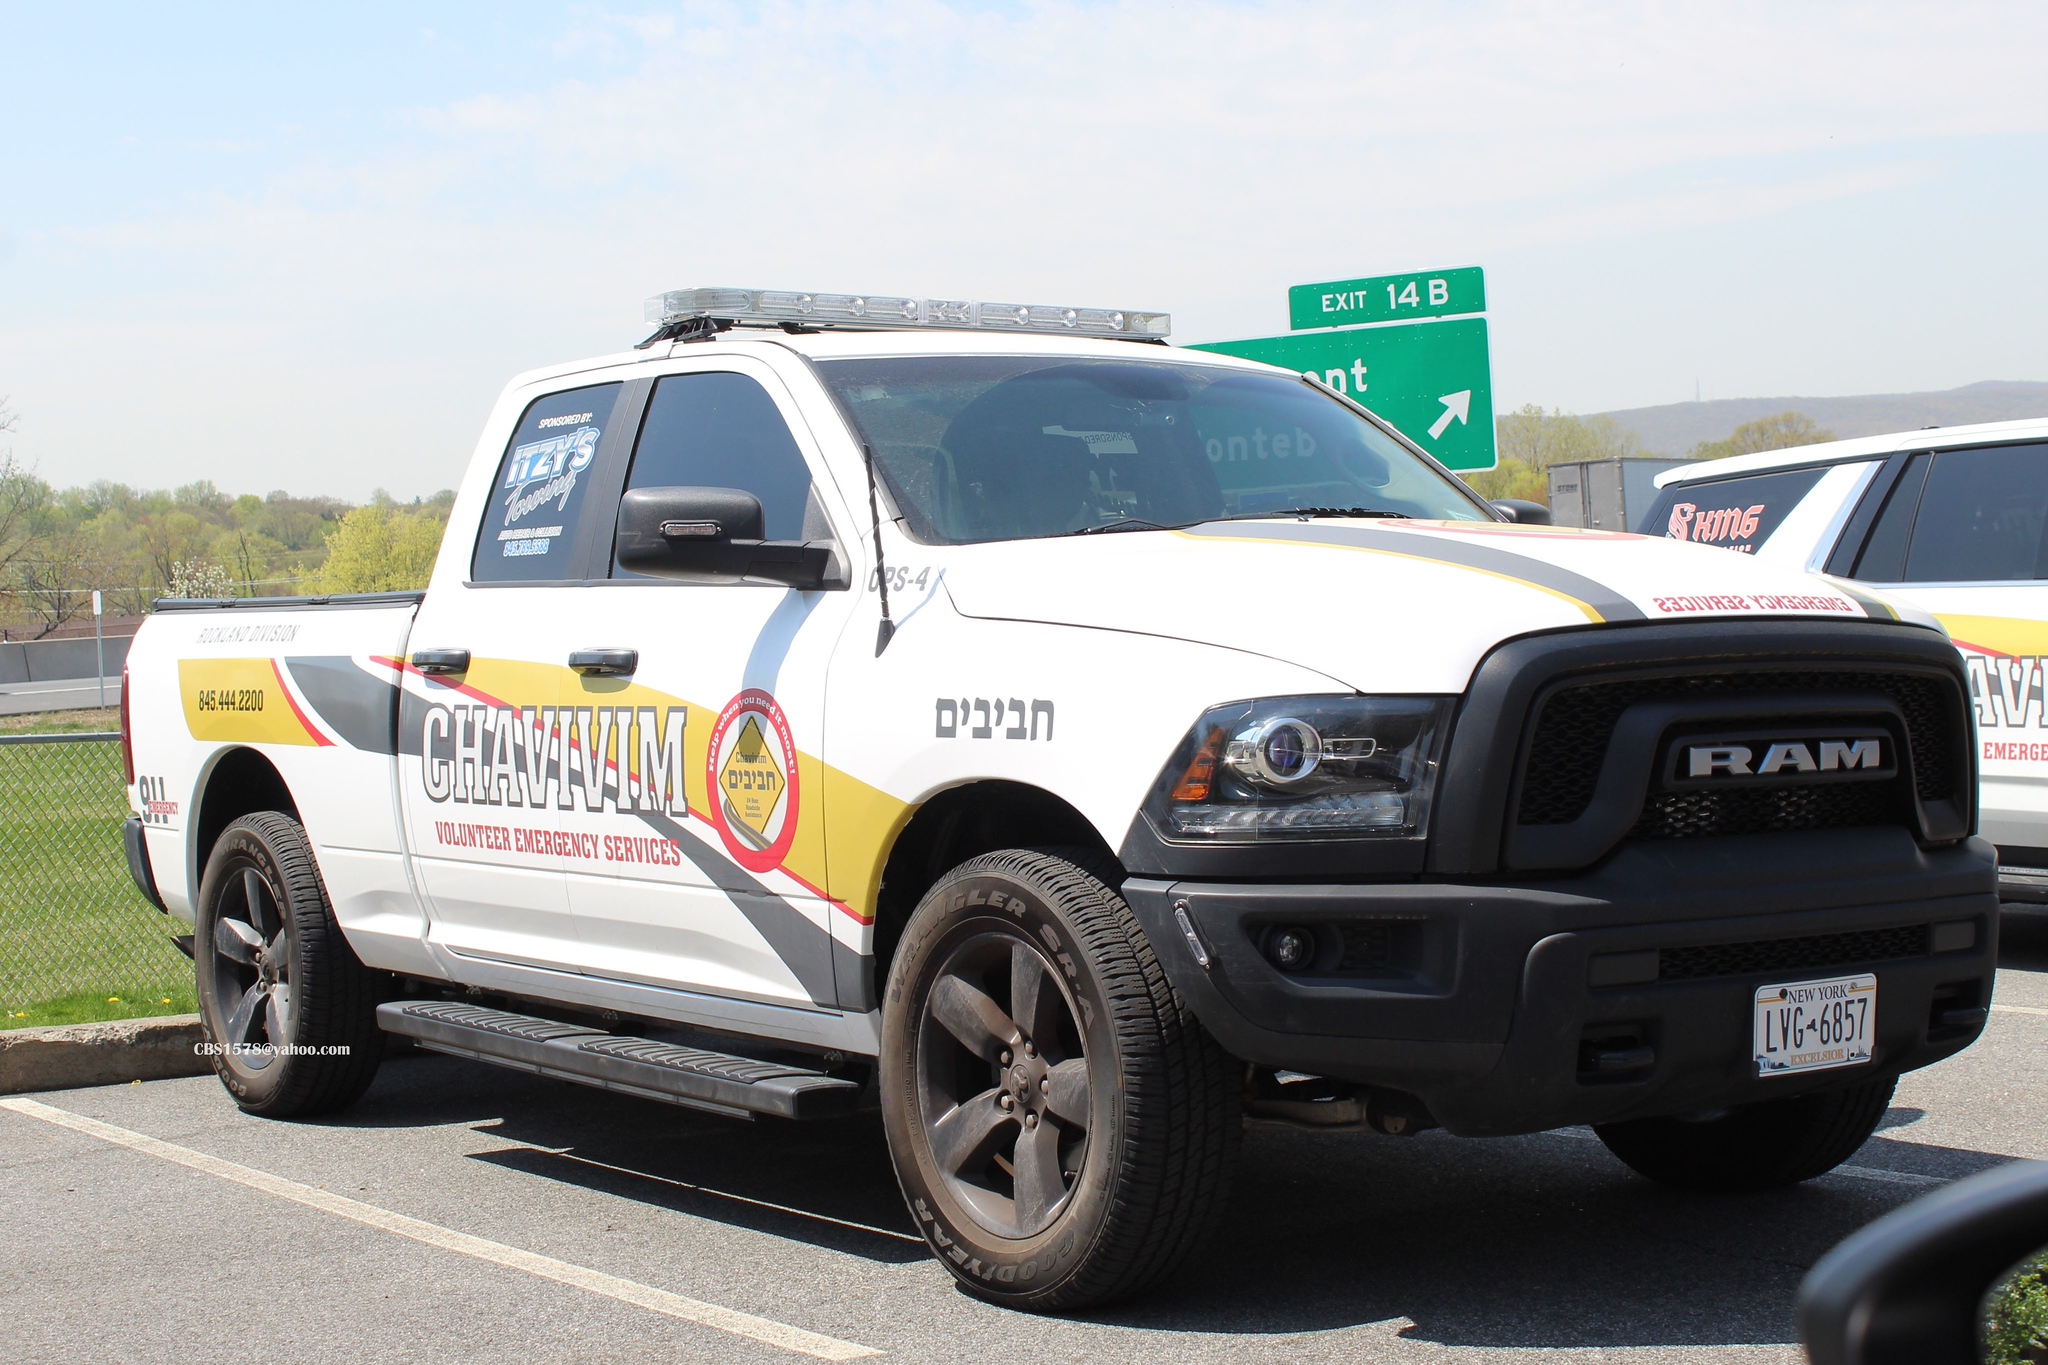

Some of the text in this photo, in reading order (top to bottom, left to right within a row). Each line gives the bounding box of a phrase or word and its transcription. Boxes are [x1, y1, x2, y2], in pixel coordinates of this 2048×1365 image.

[1321, 278, 1449, 313] EXIT 14 B
[538, 412, 593, 429] SPONSORED BY:
[504, 426, 600, 489] ITZY'S
[505, 471, 577, 526] Towing
[1692, 504, 1765, 542] KING
[196, 624, 301, 644] ROCKLAND DIVISION
[199, 689, 264, 711] 845.444.2200
[935, 697, 1055, 742] חביבים
[709, 732, 720, 772] Help
[718, 703, 738, 730] when
[739, 697, 755, 708] you
[756, 697, 776, 715] need
[775, 711, 783, 725] it
[422, 702, 689, 818] CHAVIVIM
[1689, 738, 1880, 777] RAM
[139, 775, 169, 824] 911
[728, 769, 776, 791] חביבים
[435, 821, 681, 867] VOLUNTEER EMERGENCY SERVICES
[891, 889, 1095, 1030] WRANGLER SR-A
[1788, 984, 1849, 1004] NEW YORK
[1790, 1049, 1844, 1066] EXCELSIOR
[914, 1197, 1076, 1283] GOODYEAR
